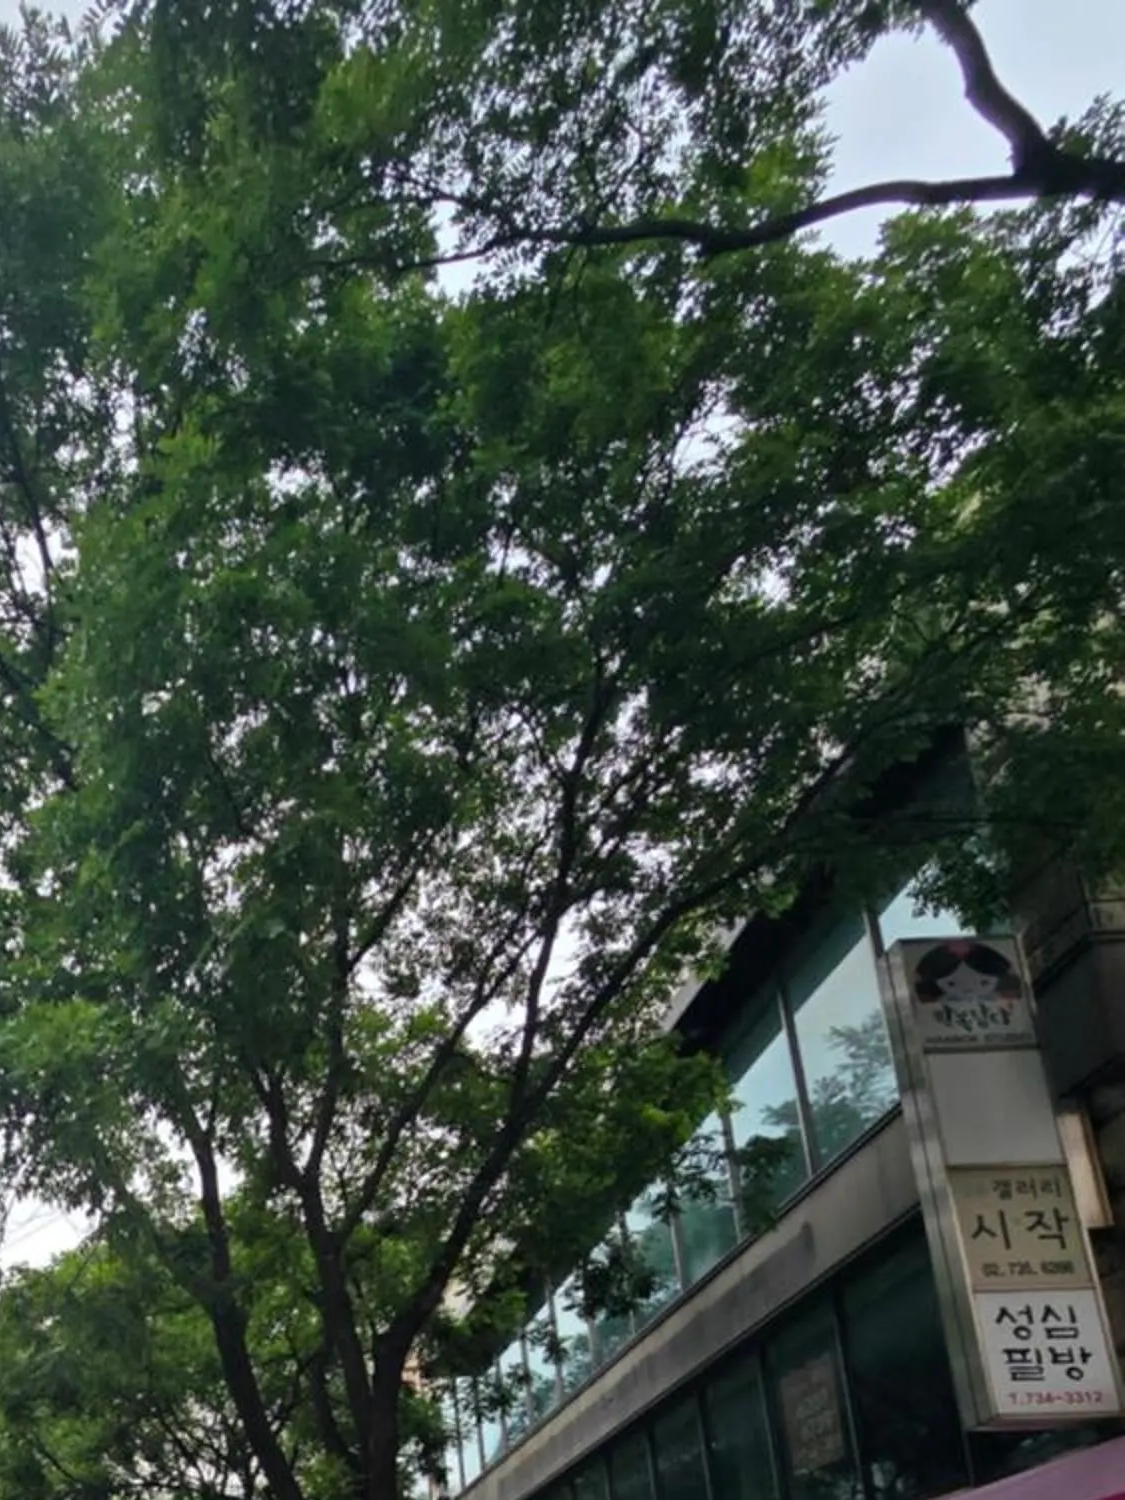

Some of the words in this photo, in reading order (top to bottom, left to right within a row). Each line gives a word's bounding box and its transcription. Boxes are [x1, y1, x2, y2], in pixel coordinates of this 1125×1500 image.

[992, 1178, 1062, 1199] 갤러리
[971, 1208, 1069, 1251] 시작
[995, 1304, 1079, 1341] 성심
[1002, 1346, 1092, 1382] 필방
